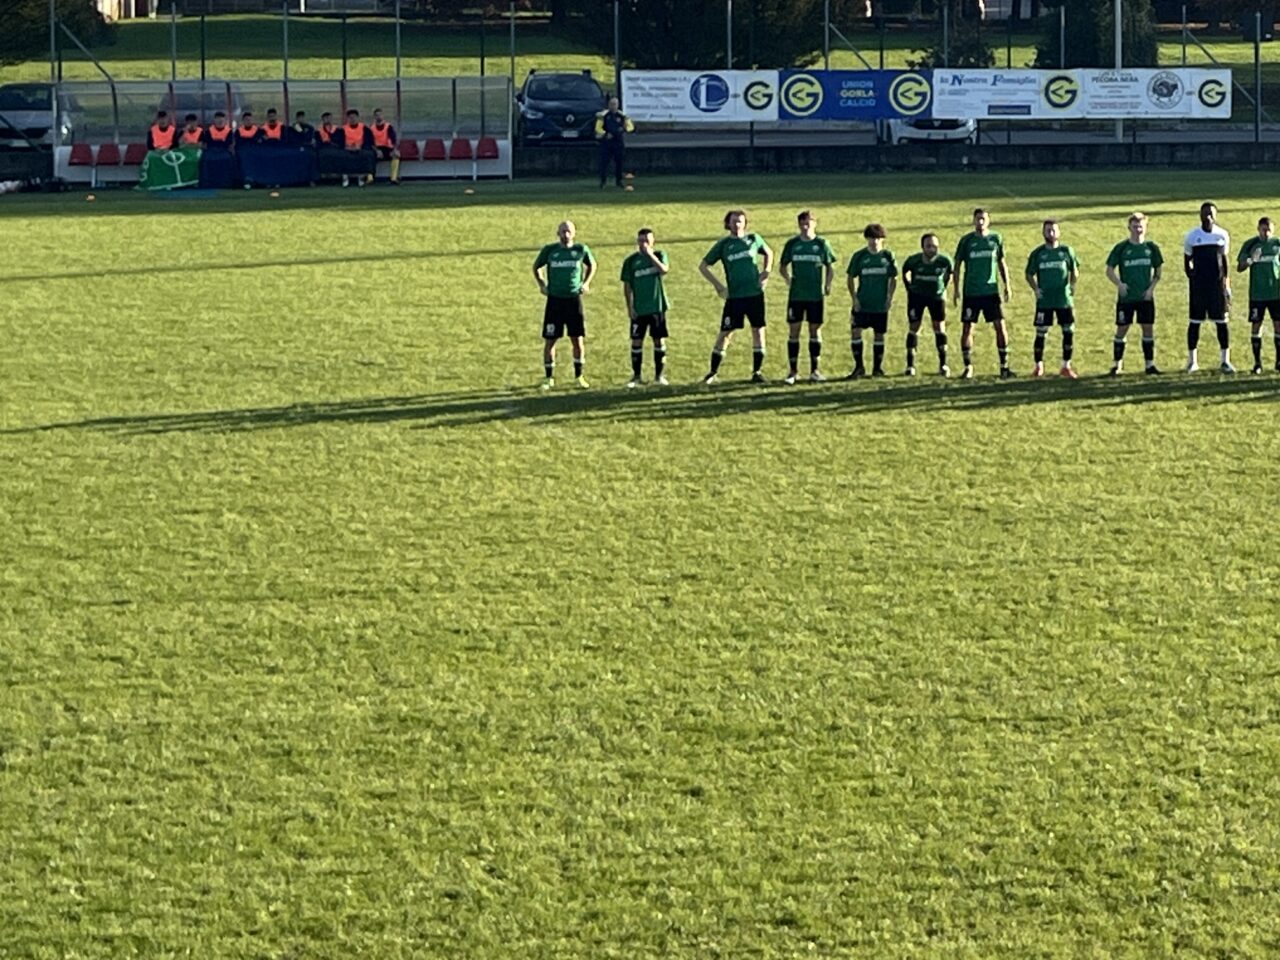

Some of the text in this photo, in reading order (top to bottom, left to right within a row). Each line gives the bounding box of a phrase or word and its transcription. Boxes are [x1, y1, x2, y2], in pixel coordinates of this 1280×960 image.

[841, 80, 874, 88] UNION
[840, 89, 875, 98] GORLA
[839, 98, 876, 107] CALCIO
